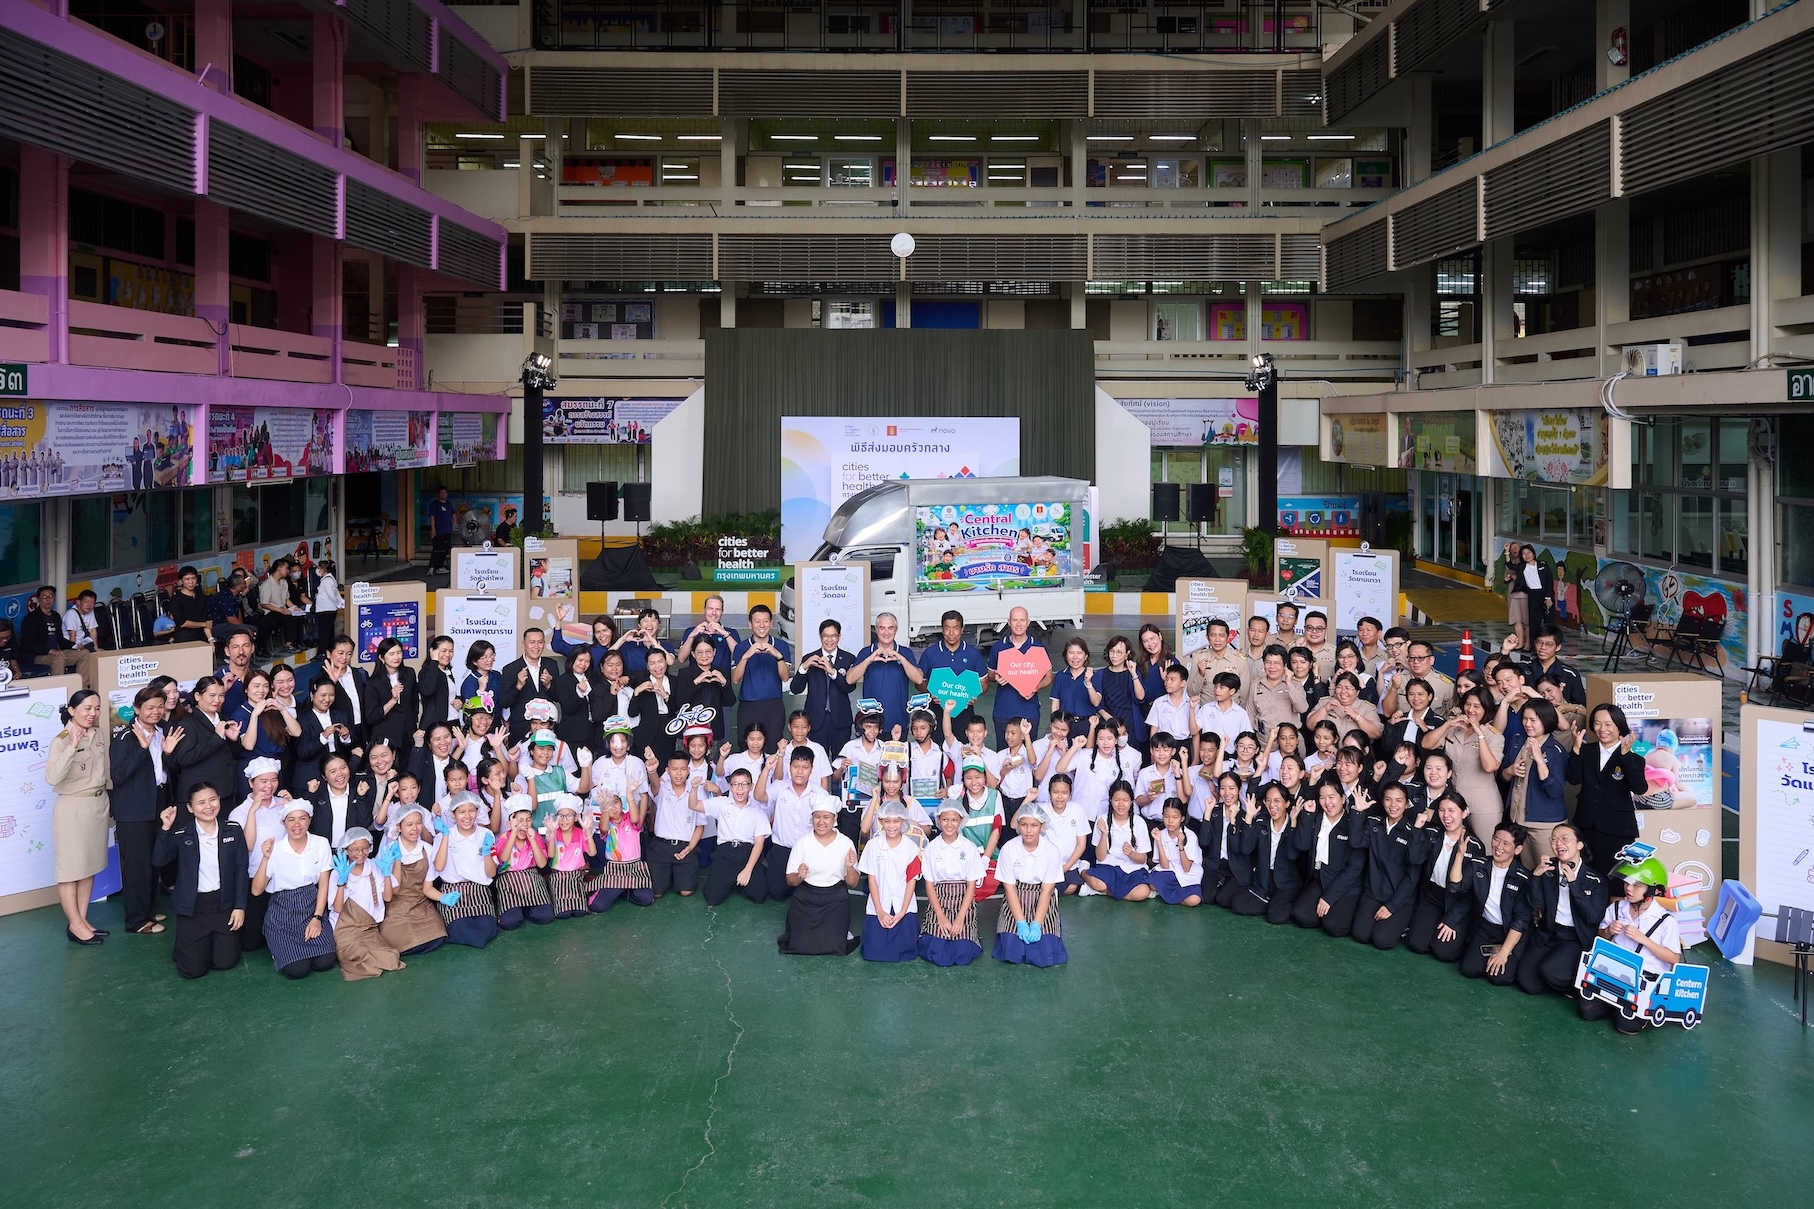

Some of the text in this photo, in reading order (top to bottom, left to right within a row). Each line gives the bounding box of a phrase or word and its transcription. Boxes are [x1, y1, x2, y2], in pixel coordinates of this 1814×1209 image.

[561, 398, 614, 409] สมรรถนะที่ 7
[1144, 400, 1170, 408] (vision)
[27, 407, 34, 420] 3
[575, 419, 606, 429] นวัตกรรม
[851, 441, 950, 453] พิธีส่งมอบครัวกลาง
[842, 462, 869, 471] cities
[842, 471, 890, 481] for better
[965, 513, 1012, 525] Central
[961, 524, 1018, 539] Kitchen
[718, 536, 748, 547] cities
[718, 547, 769, 558] for better
[718, 558, 754, 569] health
[968, 562, 1020, 575] บางรัก สาทร
[717, 572, 775, 581] กรุงเทพมหานคร
[1348, 576, 1381, 584] วัดยานนาวา
[1783, 599, 1793, 619] S
[466, 617, 497, 626] โรงเรียน
[450, 626, 513, 636] วัดมหาพฤฒาราม
[119, 656, 142, 665] cities
[131, 662, 158, 671] better
[119, 671, 147, 679] health
[941, 681, 967, 692] Our city,
[949, 689, 969, 698] health
[1676, 978, 1702, 989] Centern
[1674, 989, 1700, 999] Kitchen
